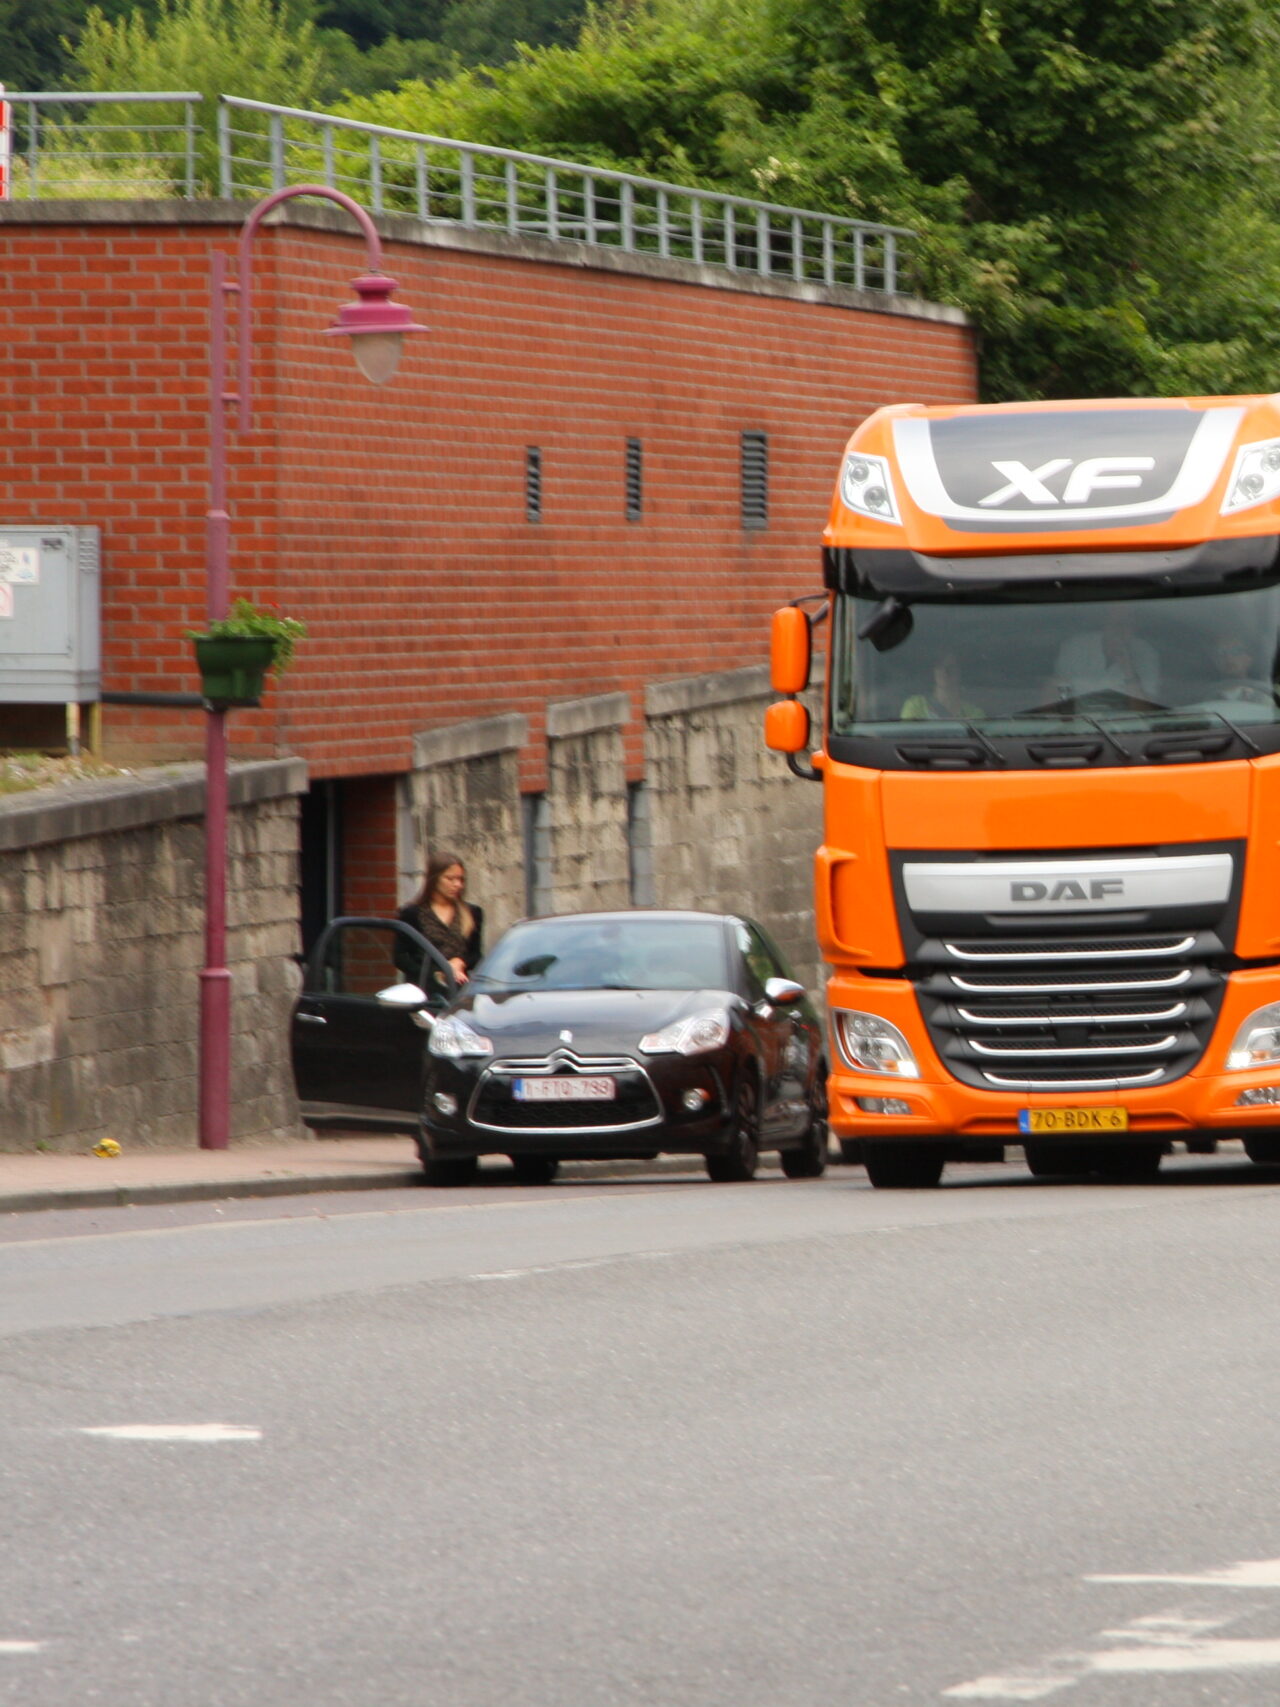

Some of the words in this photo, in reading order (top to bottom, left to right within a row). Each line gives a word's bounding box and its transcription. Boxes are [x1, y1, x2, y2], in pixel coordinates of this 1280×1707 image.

[978, 457, 1156, 507] XF
[1010, 878, 1125, 902] DAF
[1033, 1109, 1121, 1128] 70-BDK-6
